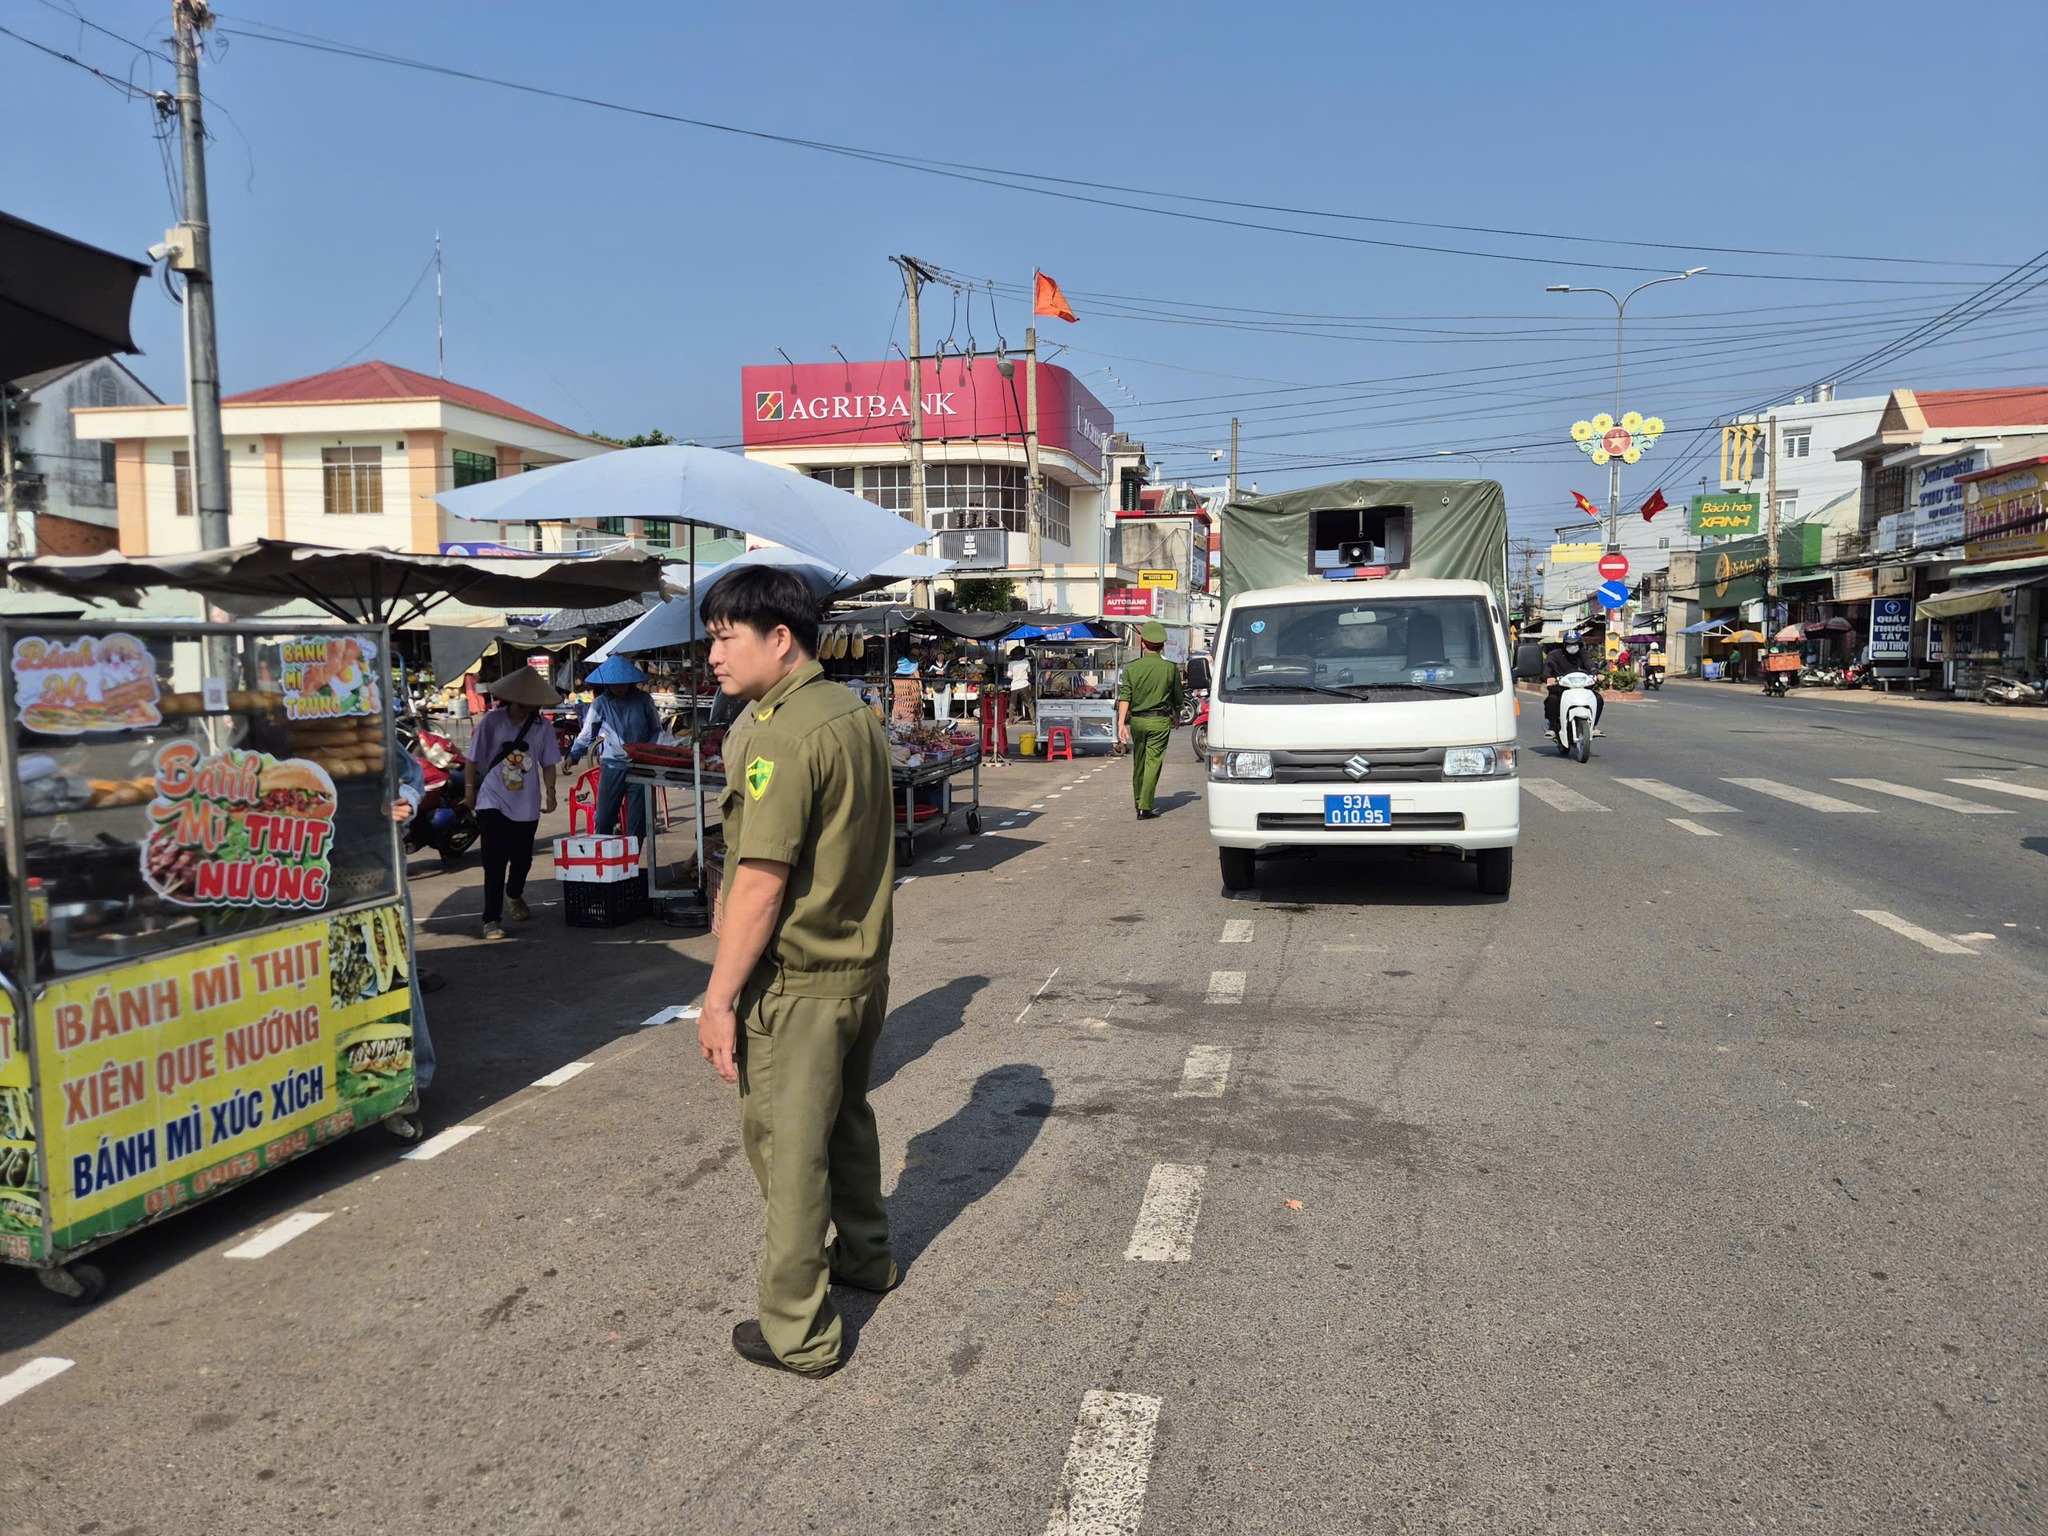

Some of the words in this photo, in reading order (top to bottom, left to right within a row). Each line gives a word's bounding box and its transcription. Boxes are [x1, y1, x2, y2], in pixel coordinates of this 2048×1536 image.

[788, 391, 958, 420] AGRIBANK
[1702, 502, 1730, 513] Bách
[1945, 484, 1963, 501] TH
[1699, 515, 1750, 528] XANH
[16, 640, 95, 670] Bánh
[1872, 641, 1888, 651] THU
[1332, 810, 1383, 823] 010.95
[1343, 795, 1371, 809] 93A
[151, 800, 227, 852] Mì
[244, 813, 330, 860] THỊT
[197, 856, 326, 903] NƯỚNG
[56, 978, 180, 1050] BÁNH
[192, 960, 241, 1012] MÌ
[251, 939, 323, 993] THỊT
[63, 1060, 145, 1126] XIÊN
[156, 1040, 216, 1095] QUE
[226, 1004, 320, 1070] NƯỚNG
[73, 1128, 156, 1199] BÁNH
[166, 1106, 204, 1162] MÌ
[212, 1085, 263, 1146] XÚC
[271, 1066, 324, 1120] XÍCH
[193, 1151, 260, 1195] 0963
[265, 1128, 308, 1164] 589
[314, 1109, 355, 1140] 735
